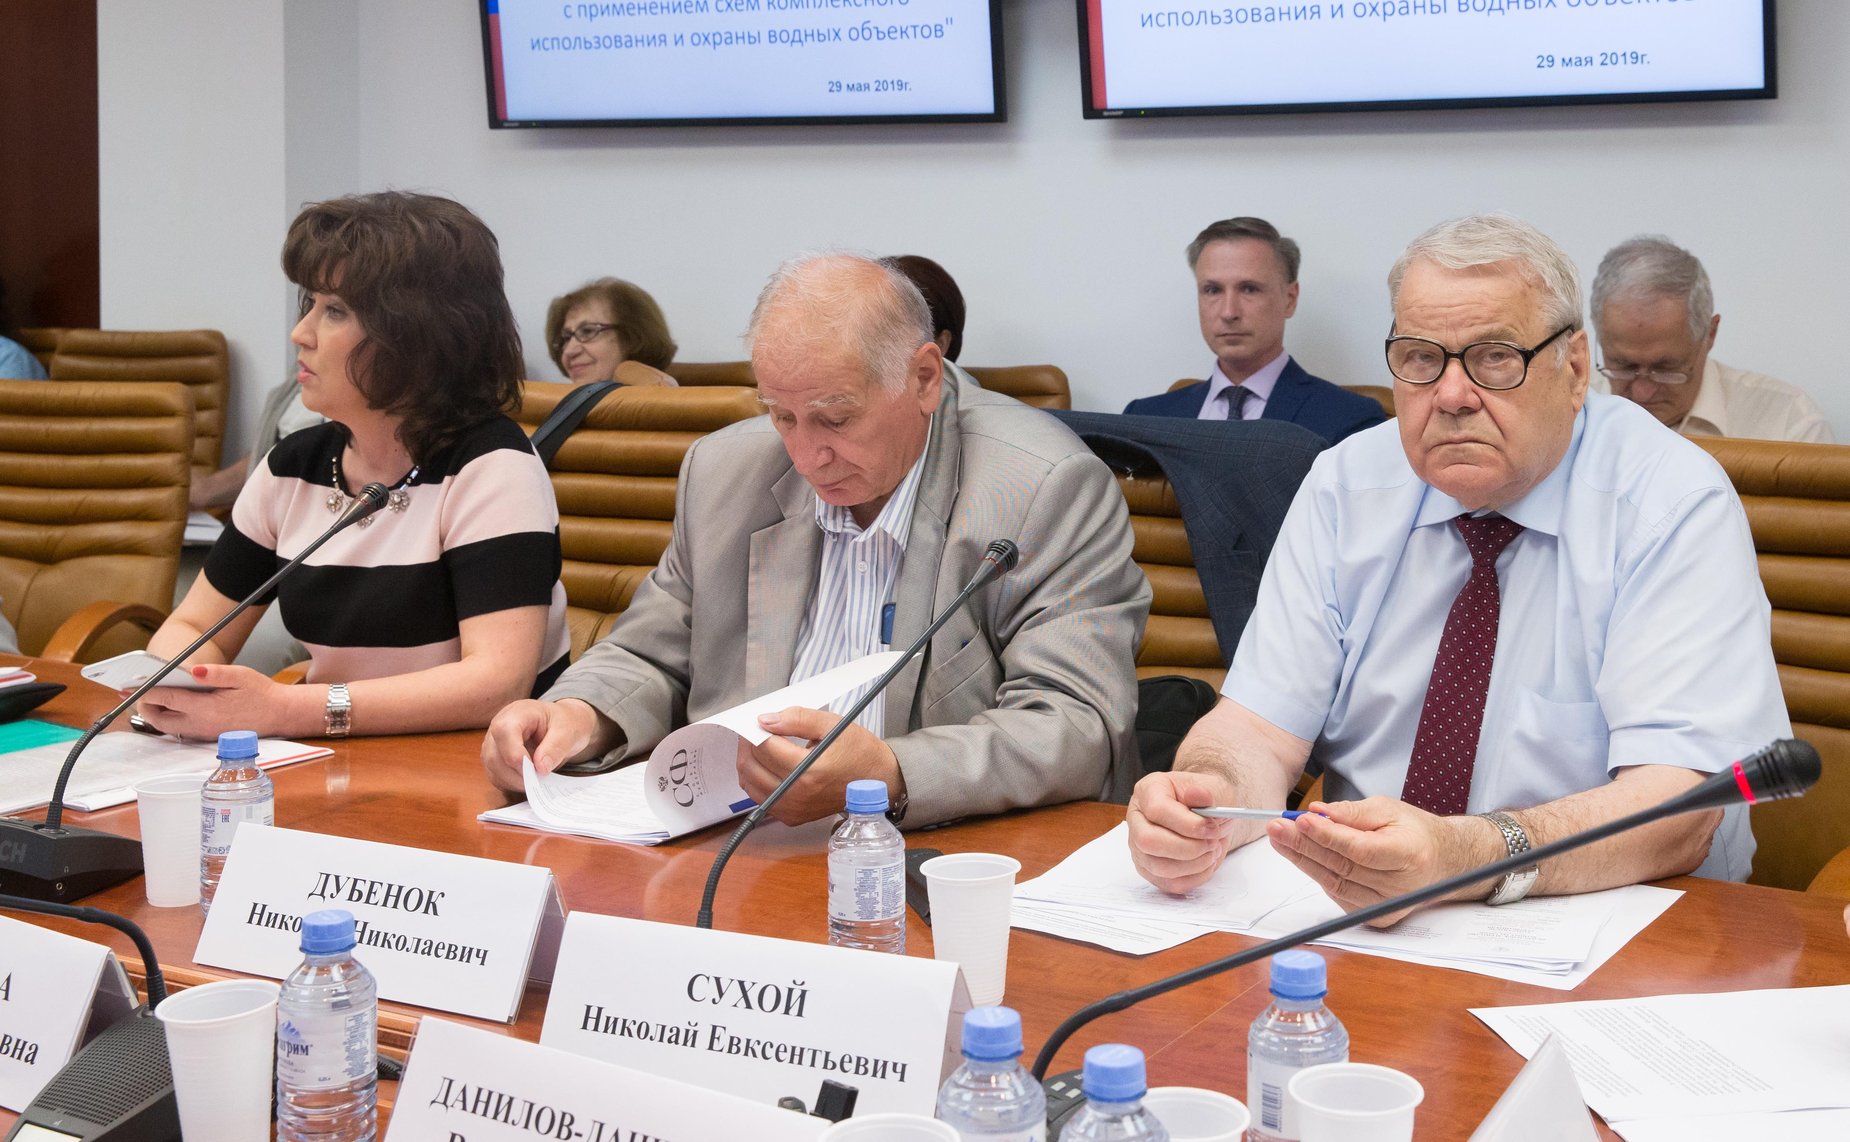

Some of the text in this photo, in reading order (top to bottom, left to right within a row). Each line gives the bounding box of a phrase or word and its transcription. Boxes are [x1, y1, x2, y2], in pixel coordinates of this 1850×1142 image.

[562, 4, 573, 19] с
[577, 0, 710, 22] применением
[715, 0, 760, 13] схем
[1140, 4, 1322, 28] использования
[1331, 3, 1344, 19] и
[1352, 0, 1448, 22] охраны
[530, 17, 954, 52] использования и охраны водных объектов"
[1536, 51, 1651, 69] 29 мая 2019г.
[828, 79, 912, 93] 29 мая 2019г.
[669, 748, 695, 808] СФ
[307, 872, 445, 916] ДУБЕНОК
[246, 902, 489, 966] Нико Николаевич
[686, 973, 810, 1018] СУХОЙ
[579, 1004, 909, 1083] Николай Евксентьевич
[429, 1076, 672, 1142] ДАНИЛОВ-Д
